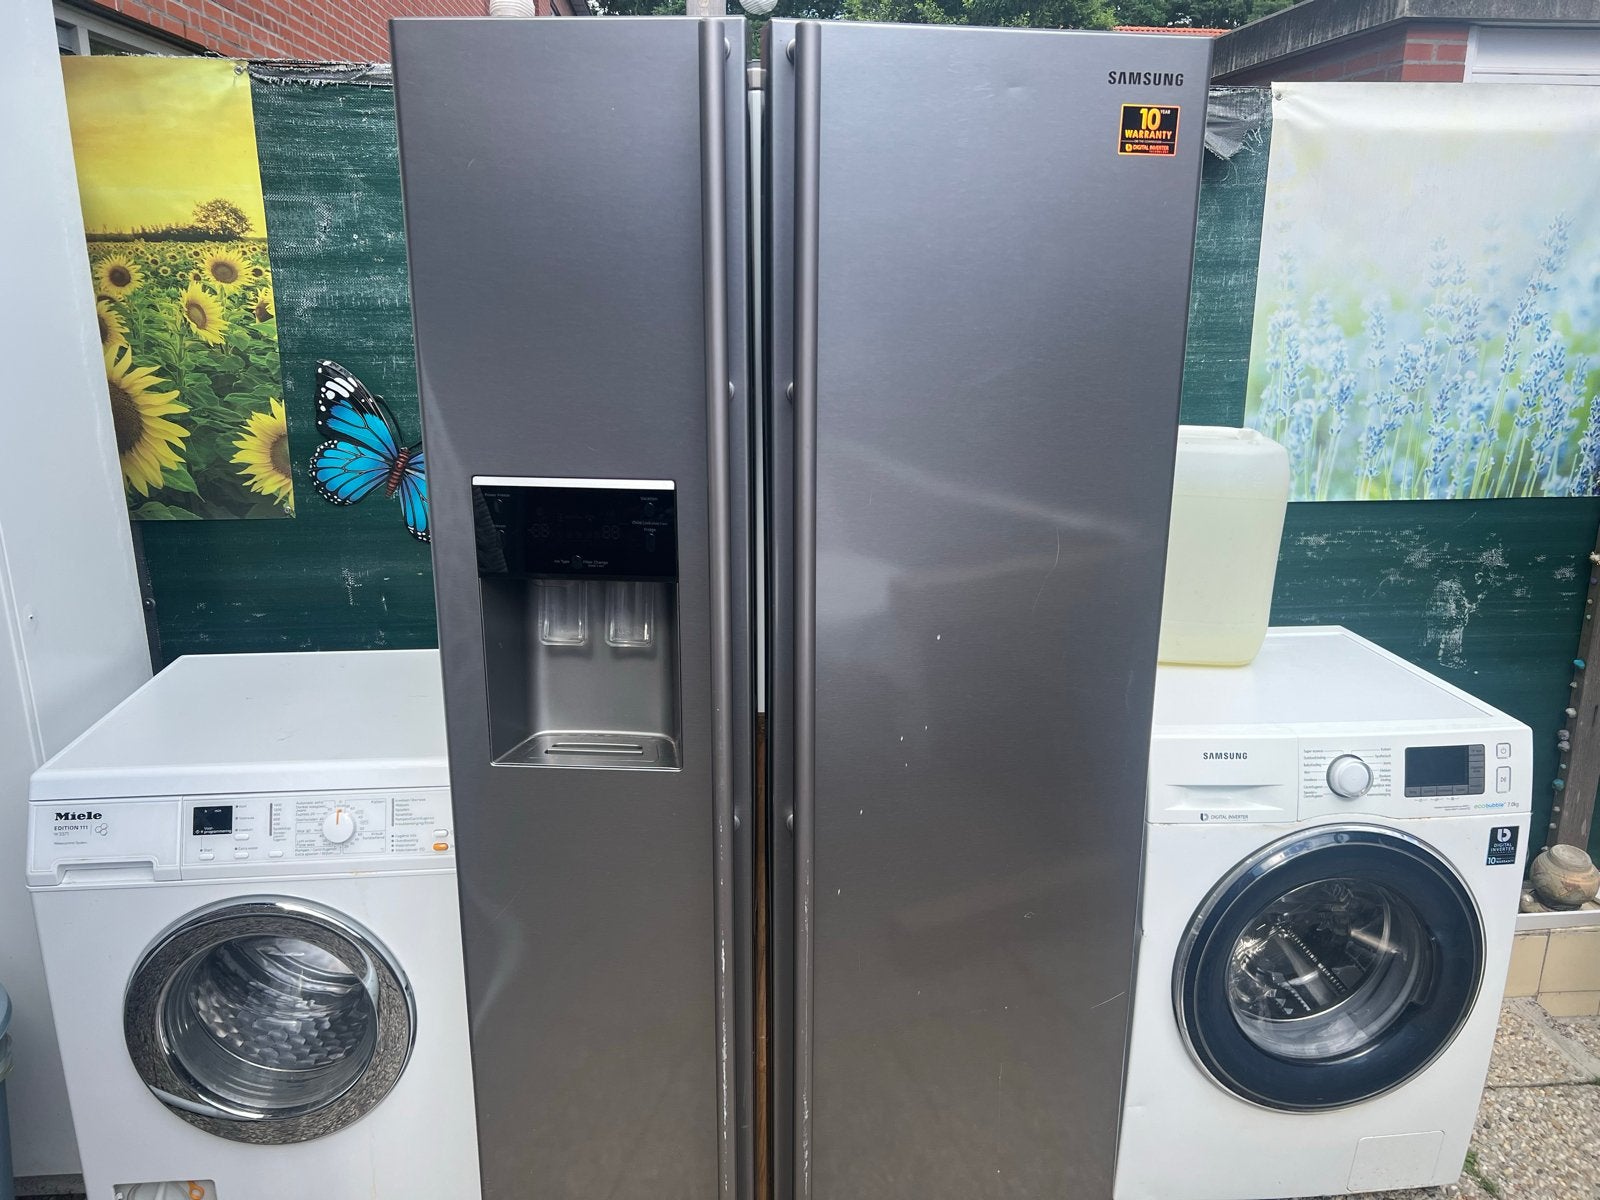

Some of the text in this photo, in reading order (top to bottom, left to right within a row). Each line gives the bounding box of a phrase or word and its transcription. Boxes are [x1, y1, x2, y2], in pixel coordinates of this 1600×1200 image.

[1108, 71, 1184, 86] SAMSUNG
[1140, 108, 1161, 130] 10
[1124, 129, 1173, 140] WARRANTY
[1203, 752, 1248, 760] SAMSUNG
[55, 811, 102, 821] Miele
[1488, 856, 1496, 864] 10
